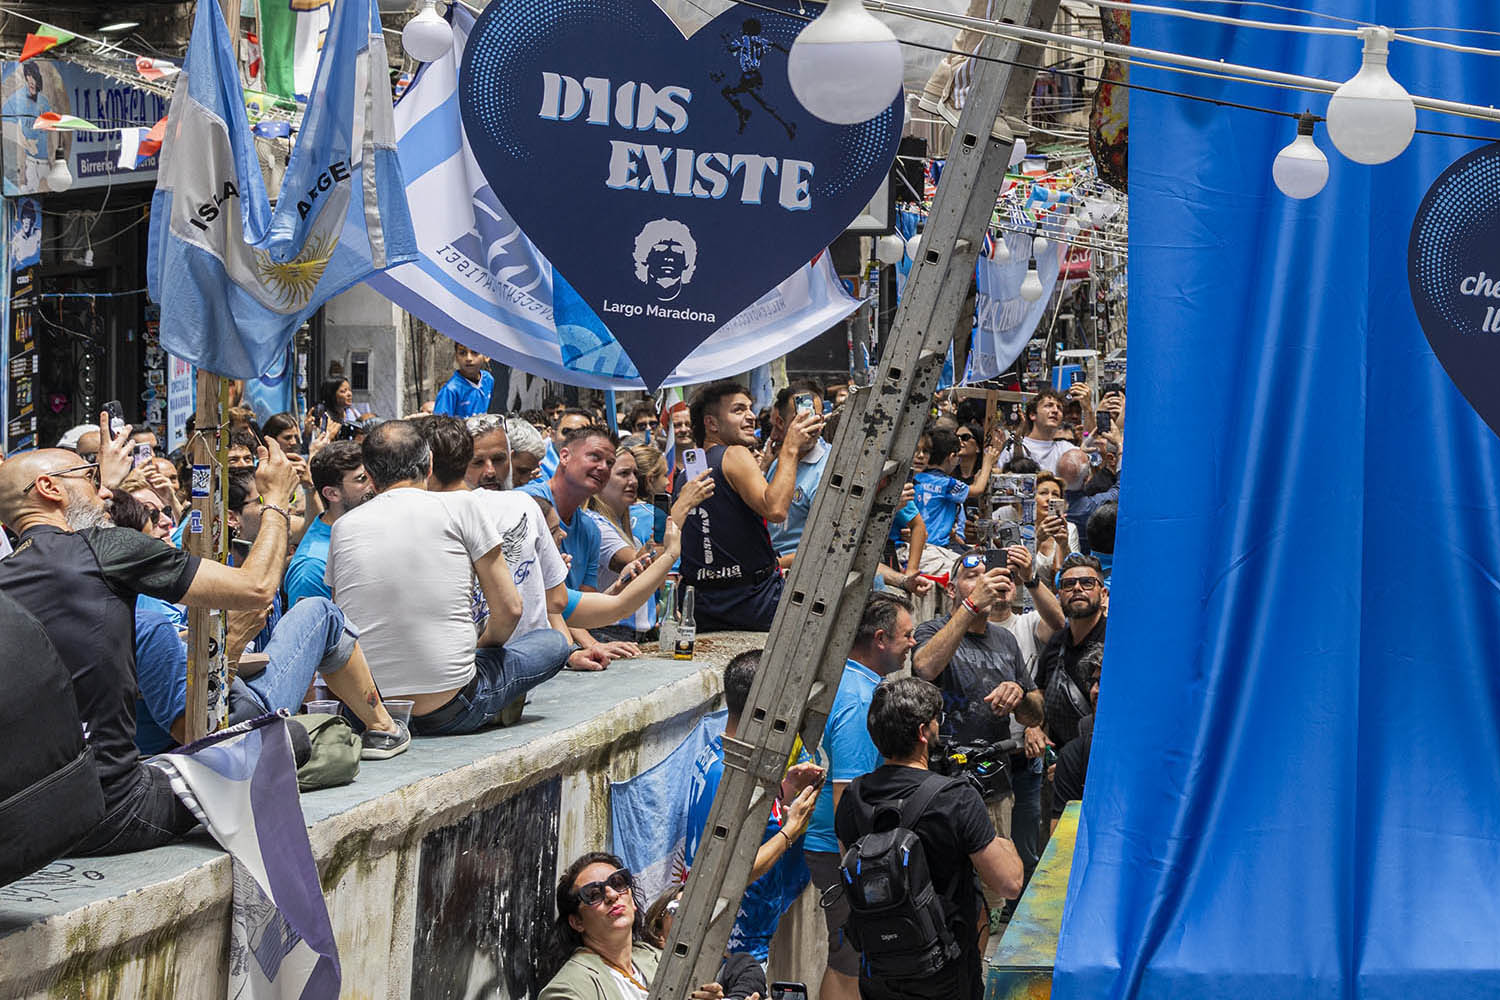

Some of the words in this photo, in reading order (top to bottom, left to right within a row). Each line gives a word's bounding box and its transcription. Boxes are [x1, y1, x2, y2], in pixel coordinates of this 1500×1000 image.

[296, 160, 353, 221] ARGE
[605, 140, 816, 212] EXISTE
[603, 300, 644, 318] Largo
[646, 305, 716, 324] Maradona
